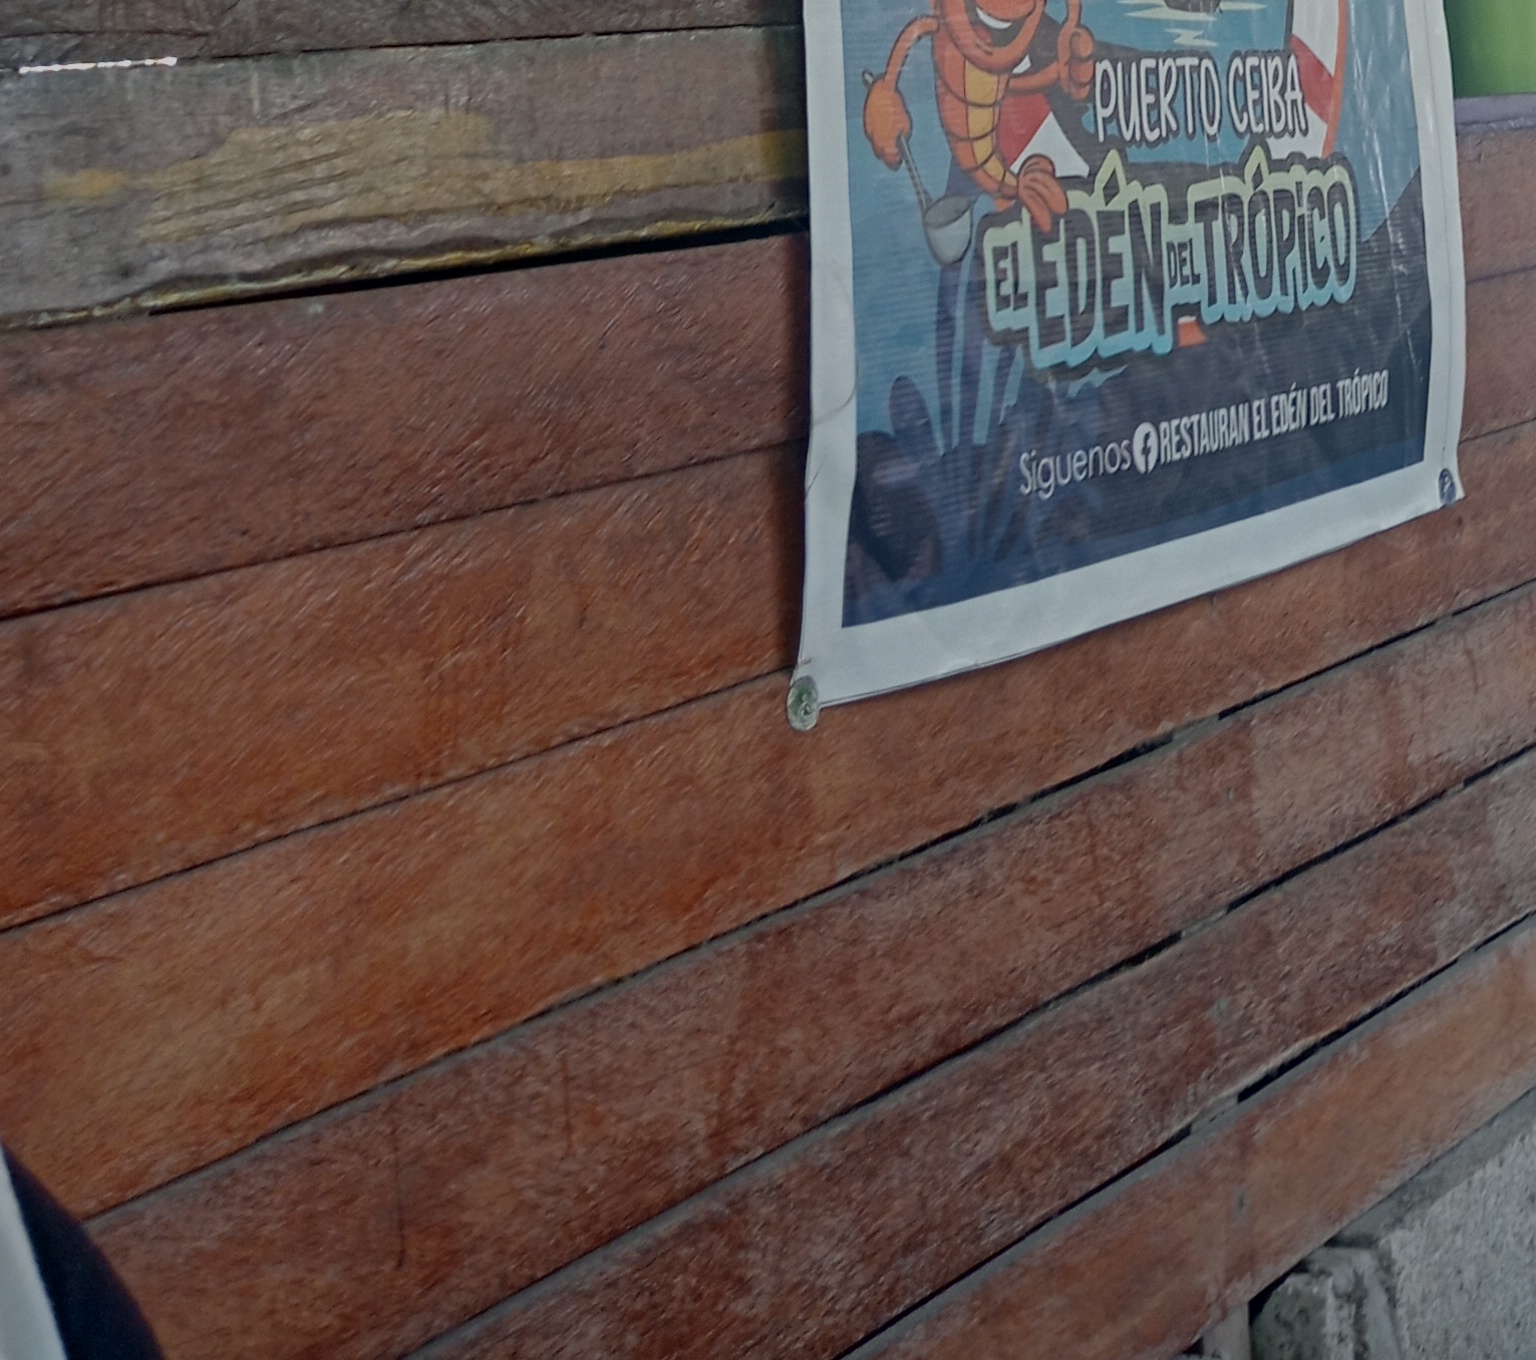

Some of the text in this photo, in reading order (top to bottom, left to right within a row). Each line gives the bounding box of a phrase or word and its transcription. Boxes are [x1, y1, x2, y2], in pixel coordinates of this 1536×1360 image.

[1095, 53, 1309, 143] PUERTO CEIBA
[992, 240, 1030, 312] EL
[1030, 165, 1166, 351] EDÉN
[1166, 237, 1200, 290] DEL
[1019, 366, 1389, 500] Síguenos RESTAURAN EL EDÉN DEL TRÓPICO
